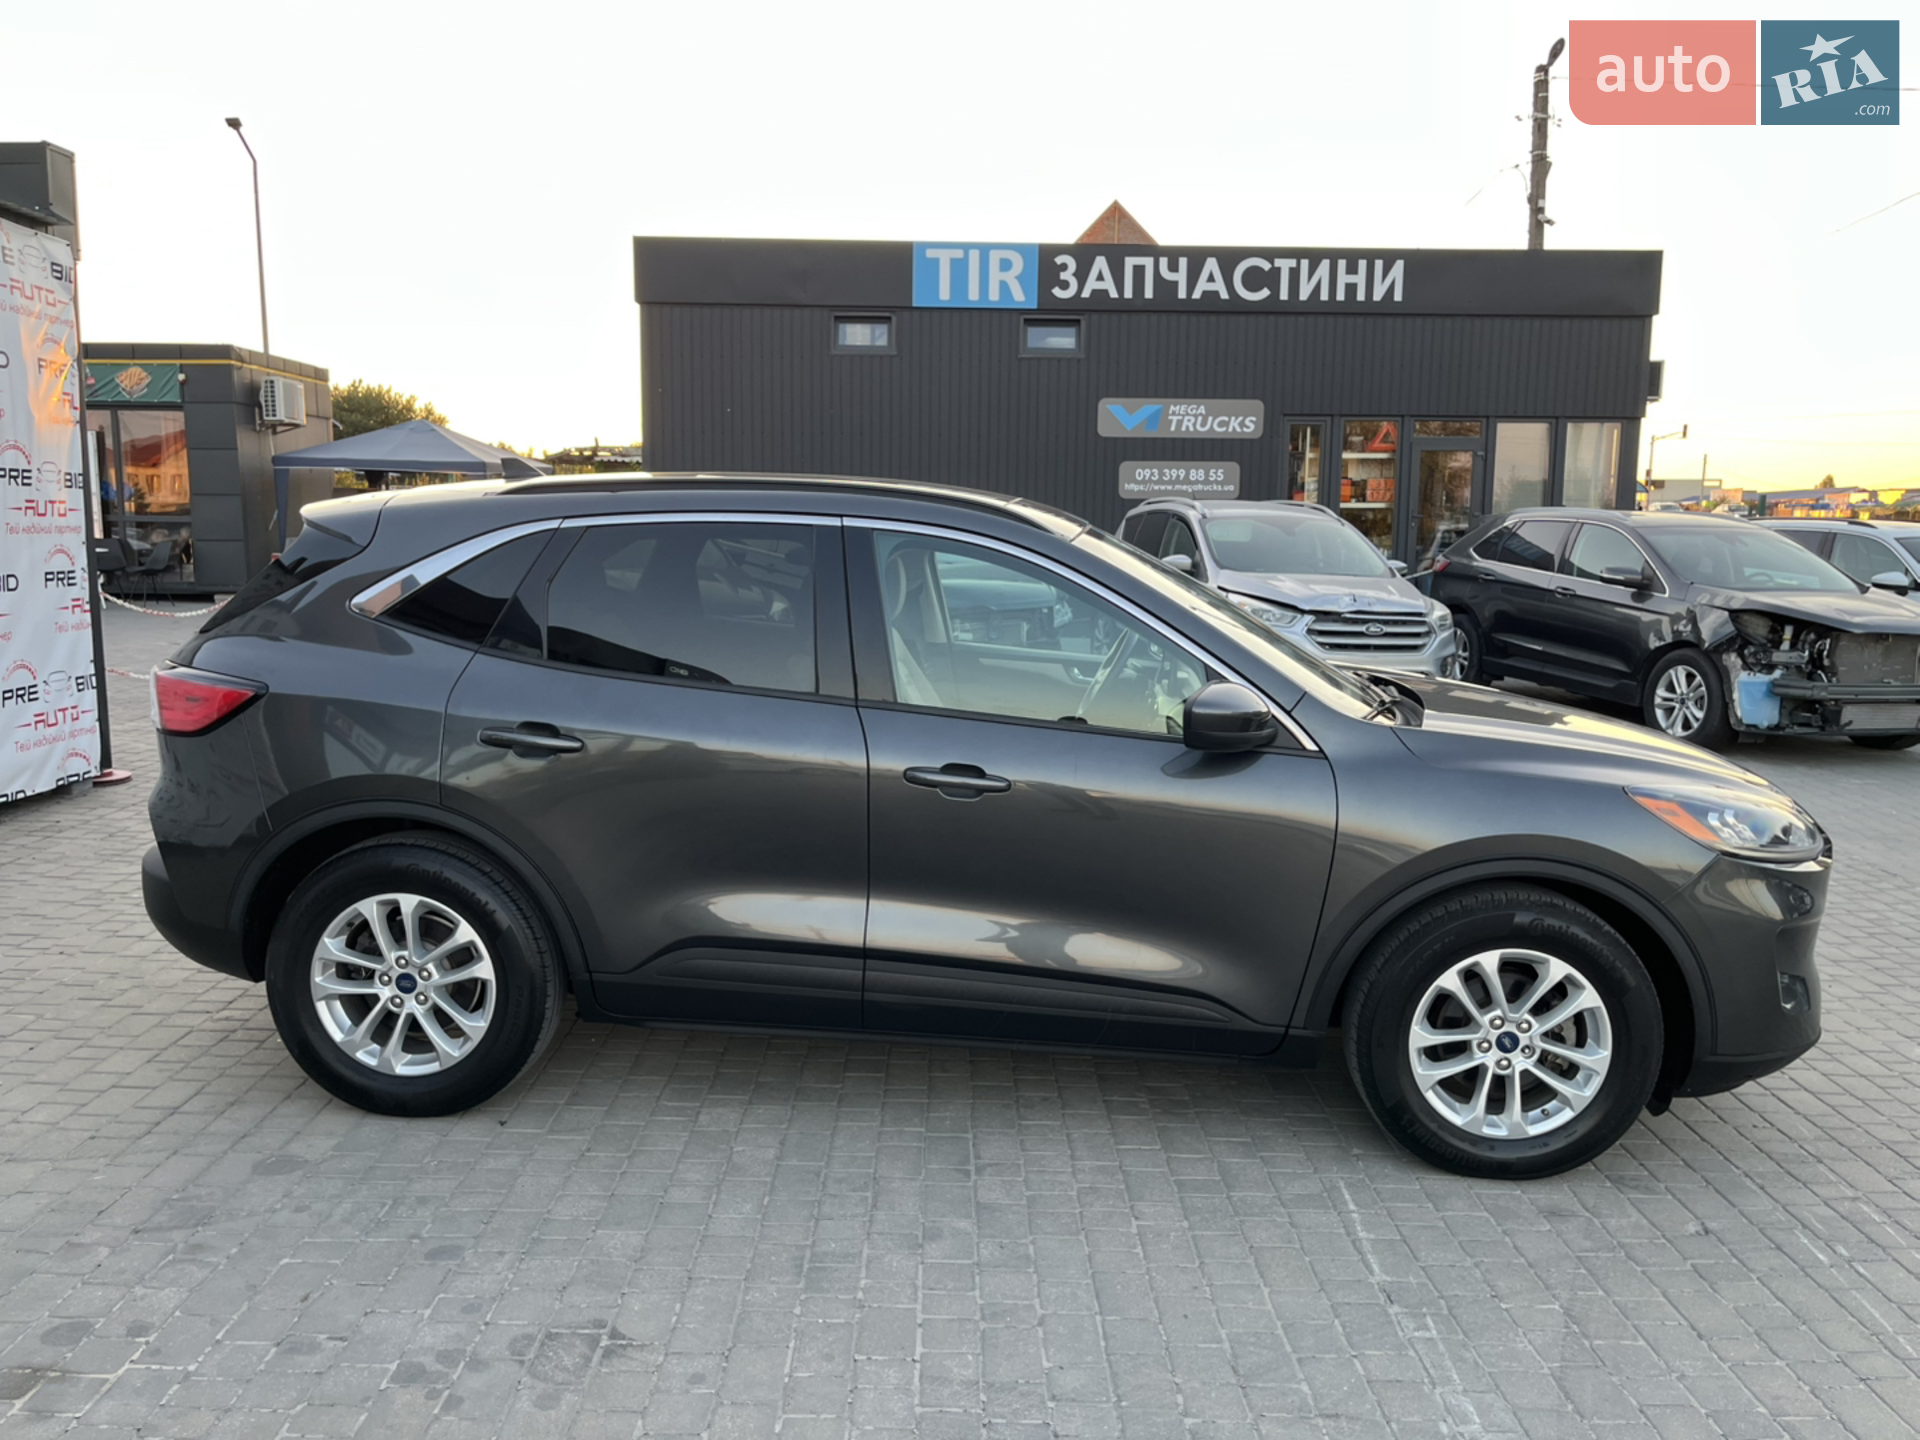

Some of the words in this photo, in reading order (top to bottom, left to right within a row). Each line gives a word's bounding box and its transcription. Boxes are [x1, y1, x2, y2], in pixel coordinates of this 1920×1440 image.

[926, 248, 1026, 302] TIR
[1051, 254, 1404, 302] ЗАПЧАСТИНИ
[9, 277, 57, 308] AUTO
[1168, 404, 1206, 415] MEGA
[1168, 416, 1257, 433] TRUCKS
[1135, 468, 1159, 481] 093
[1162, 468, 1186, 481] 399
[1189, 468, 1205, 481] 88
[1208, 468, 1225, 481] 55
[24, 499, 67, 517] AUTO
[0, 573, 19, 593] ID
[45, 570, 78, 589] PRE
[2, 684, 39, 708] PRE
[33, 705, 80, 731] AUTO
[15, 739, 31, 754] Твій
[407, 863, 490, 906] Continental
